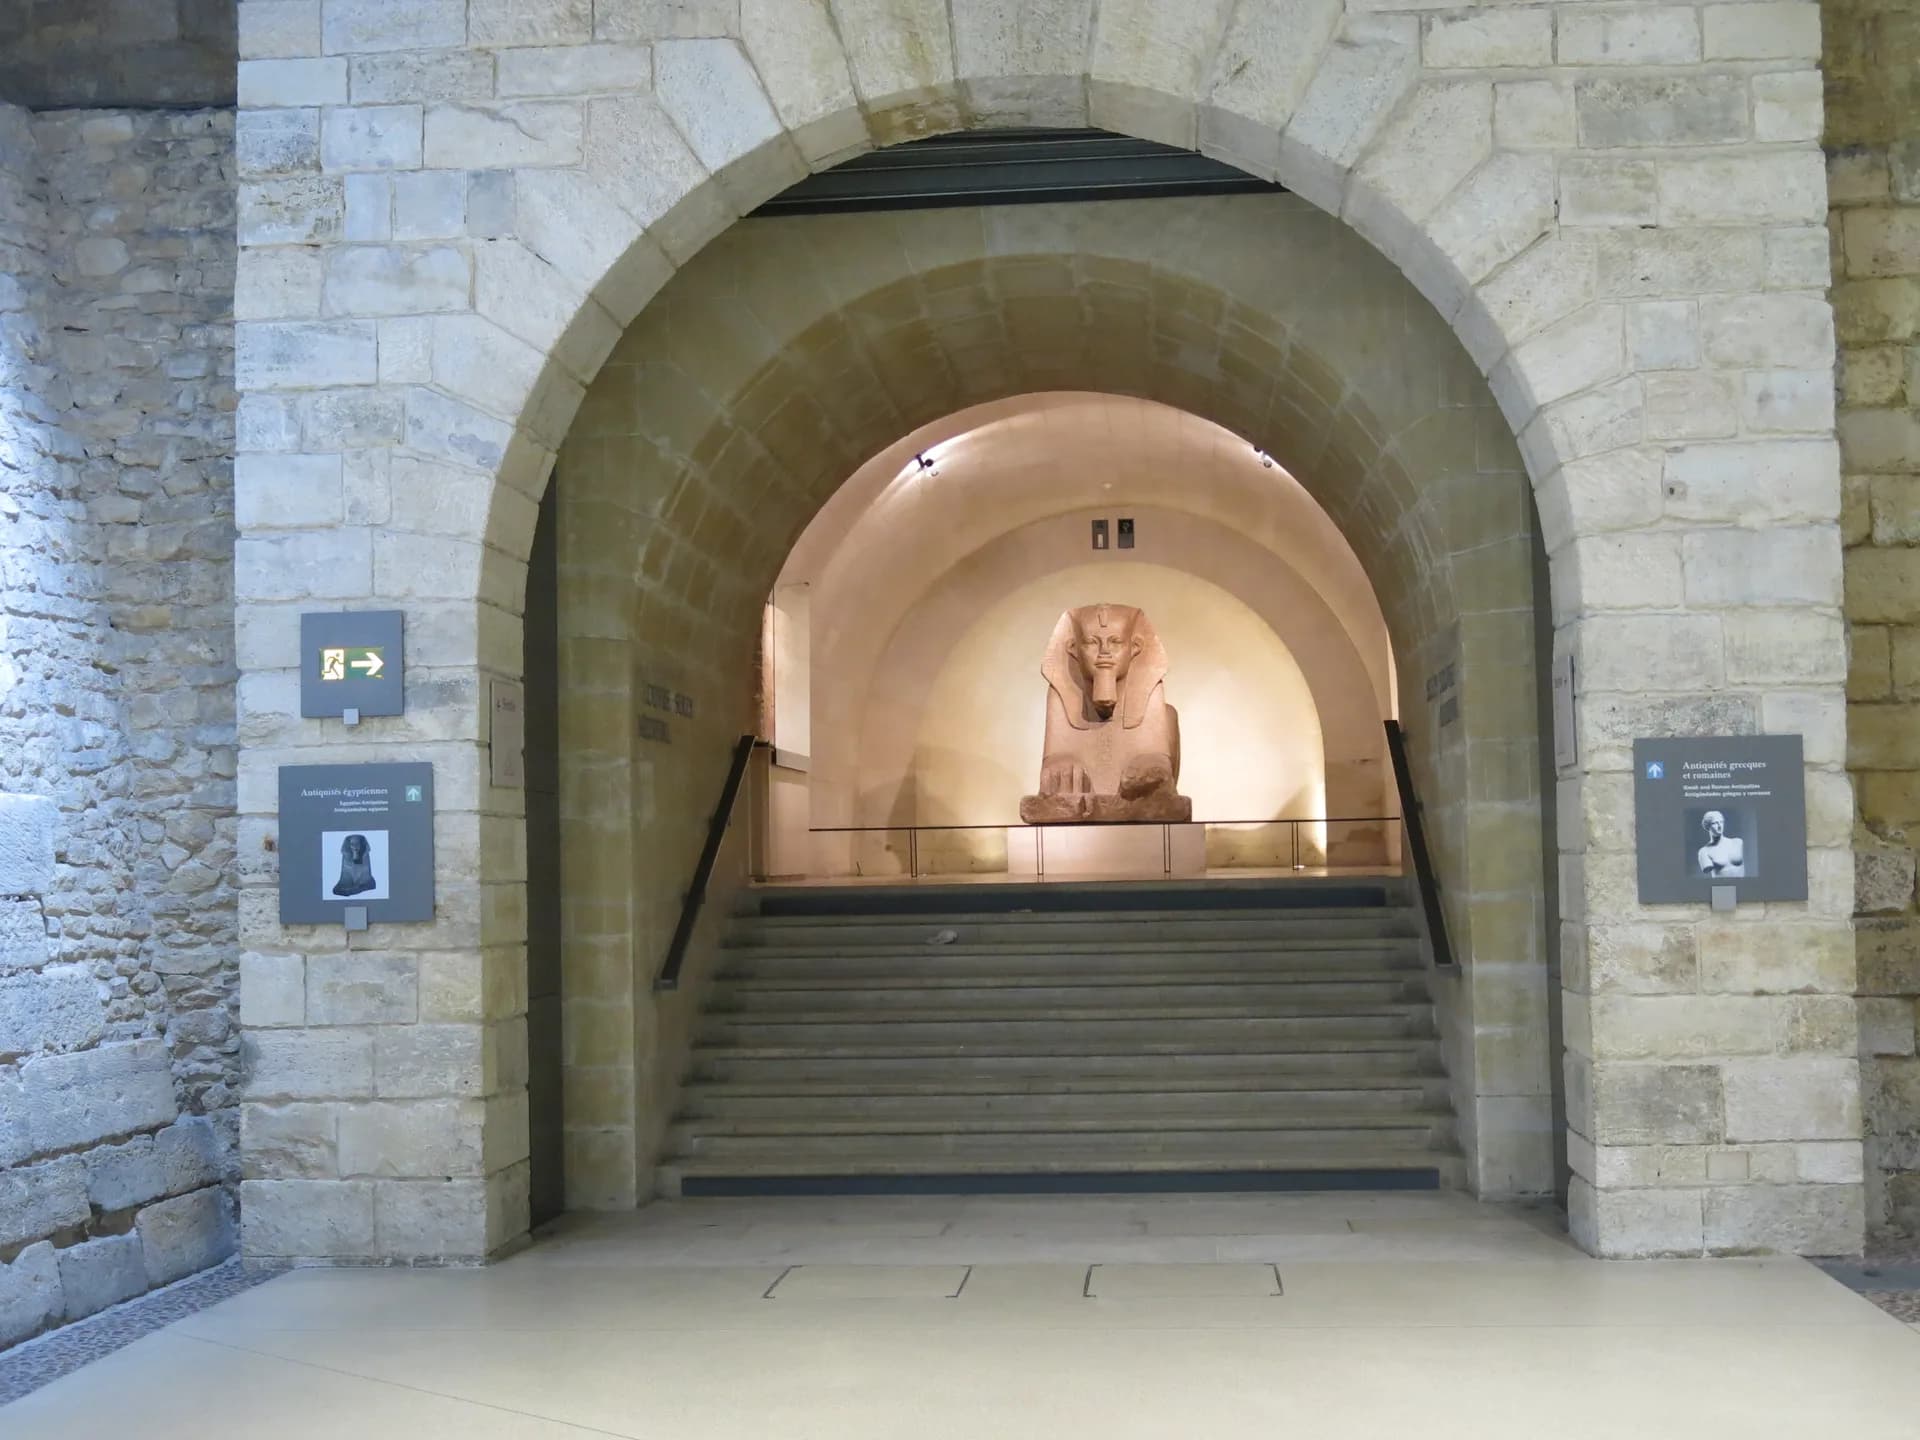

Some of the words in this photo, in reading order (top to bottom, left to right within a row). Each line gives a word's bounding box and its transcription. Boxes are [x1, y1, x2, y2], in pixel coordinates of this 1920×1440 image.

[1682, 761, 1727, 771] Antiquités
[1729, 761, 1766, 770] grecques
[1692, 771, 1731, 779] romaines
